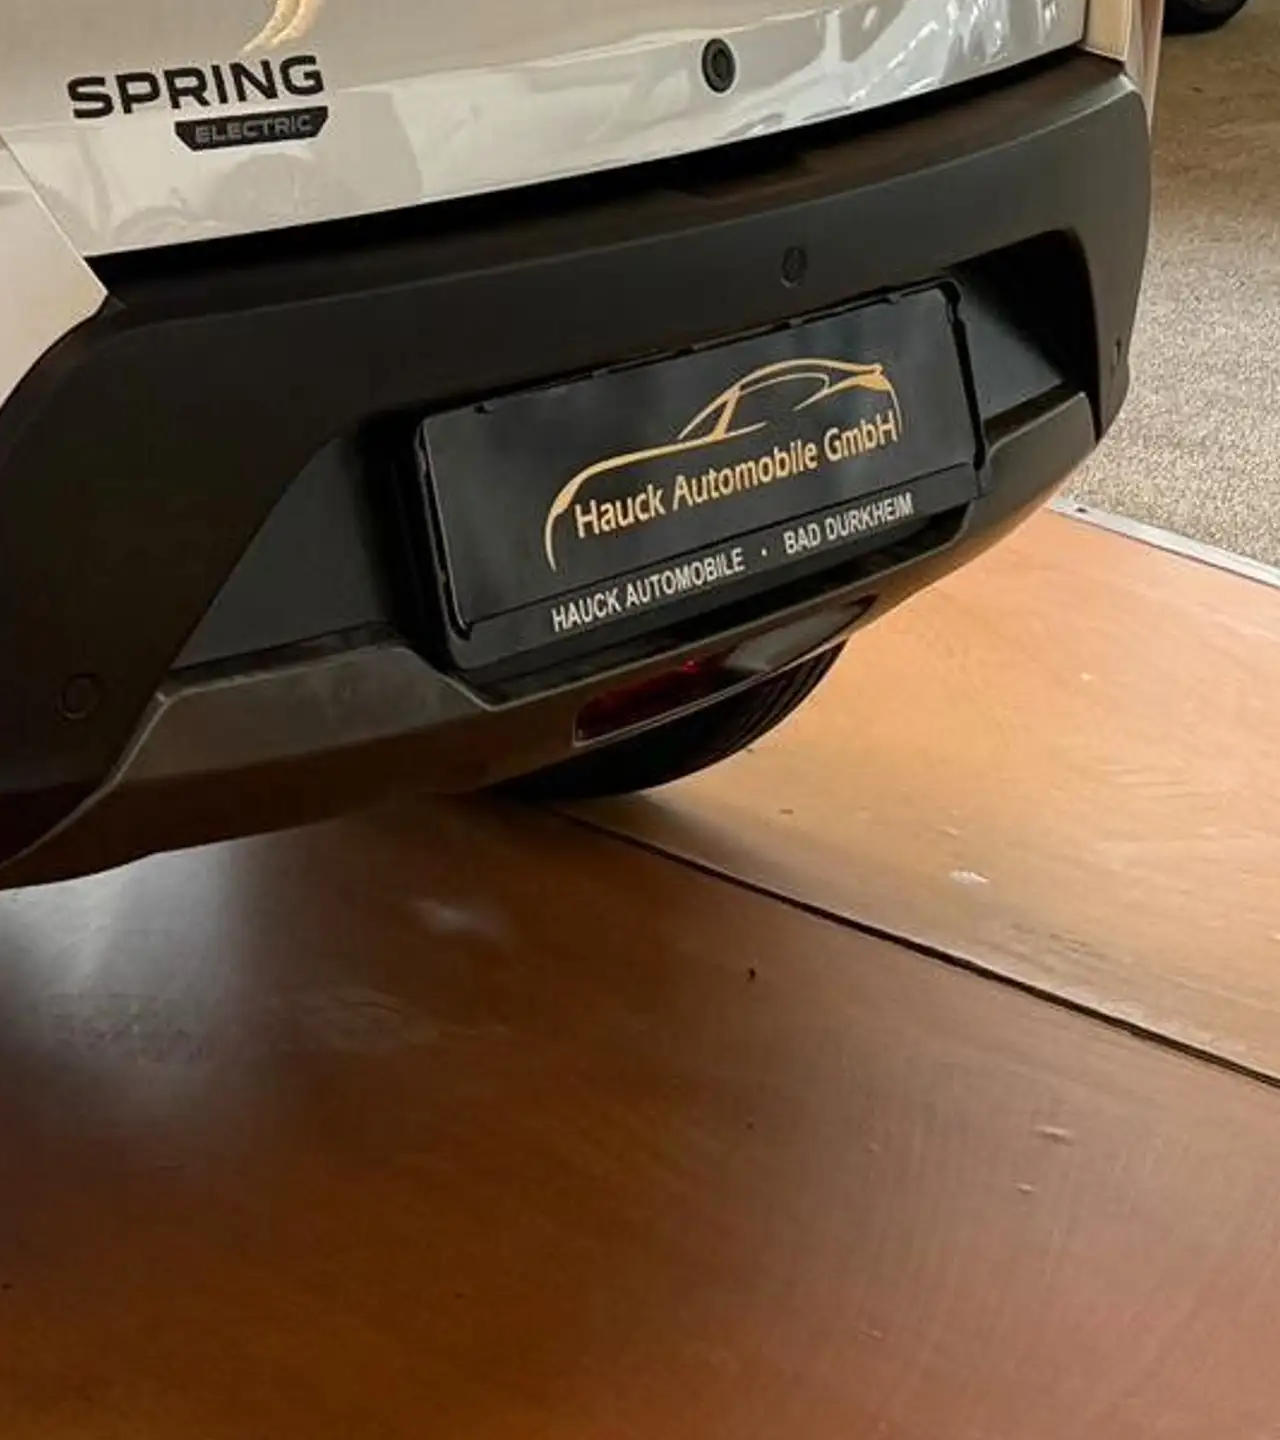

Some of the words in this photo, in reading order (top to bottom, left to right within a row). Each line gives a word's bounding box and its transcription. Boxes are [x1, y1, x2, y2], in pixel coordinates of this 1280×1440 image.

[66, 55, 325, 119] SPRING
[195, 115, 314, 144] ELECTRIC
[574, 484, 666, 538] Hauck
[672, 441, 818, 511] Automobile
[824, 411, 898, 462] GmbH
[551, 588, 623, 633] HAUCK
[625, 547, 746, 609] AUTOMOBILE
[783, 522, 822, 556] BAD
